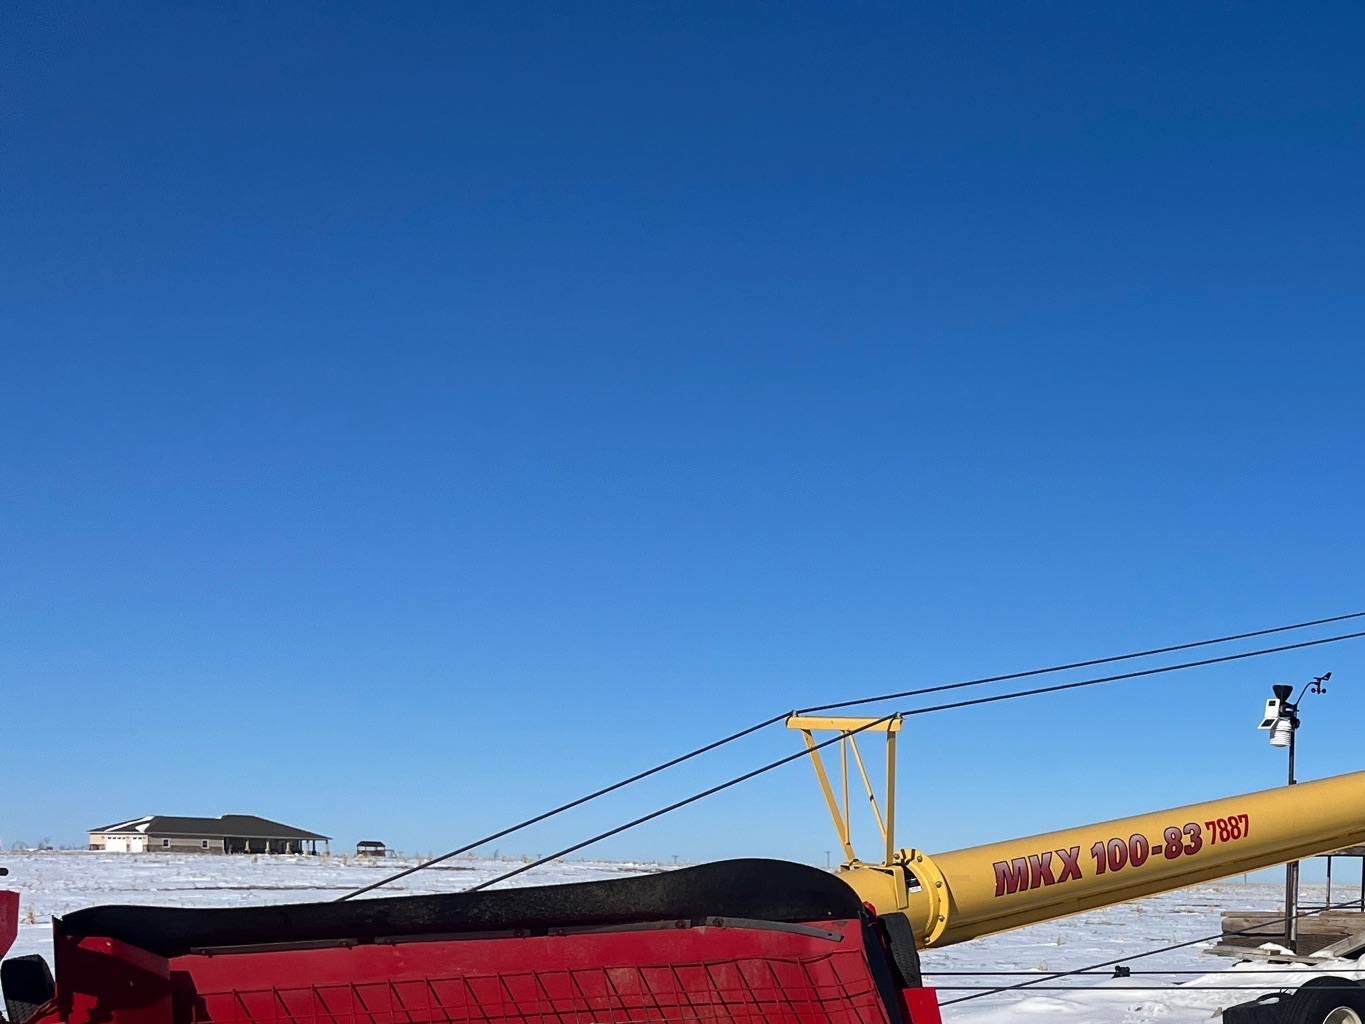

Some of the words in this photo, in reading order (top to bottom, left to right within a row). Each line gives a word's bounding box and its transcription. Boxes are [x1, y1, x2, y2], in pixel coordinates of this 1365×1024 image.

[1204, 814, 1250, 845] 7887
[993, 846, 1083, 897] MKX
[1091, 823, 1203, 875] 100-83
